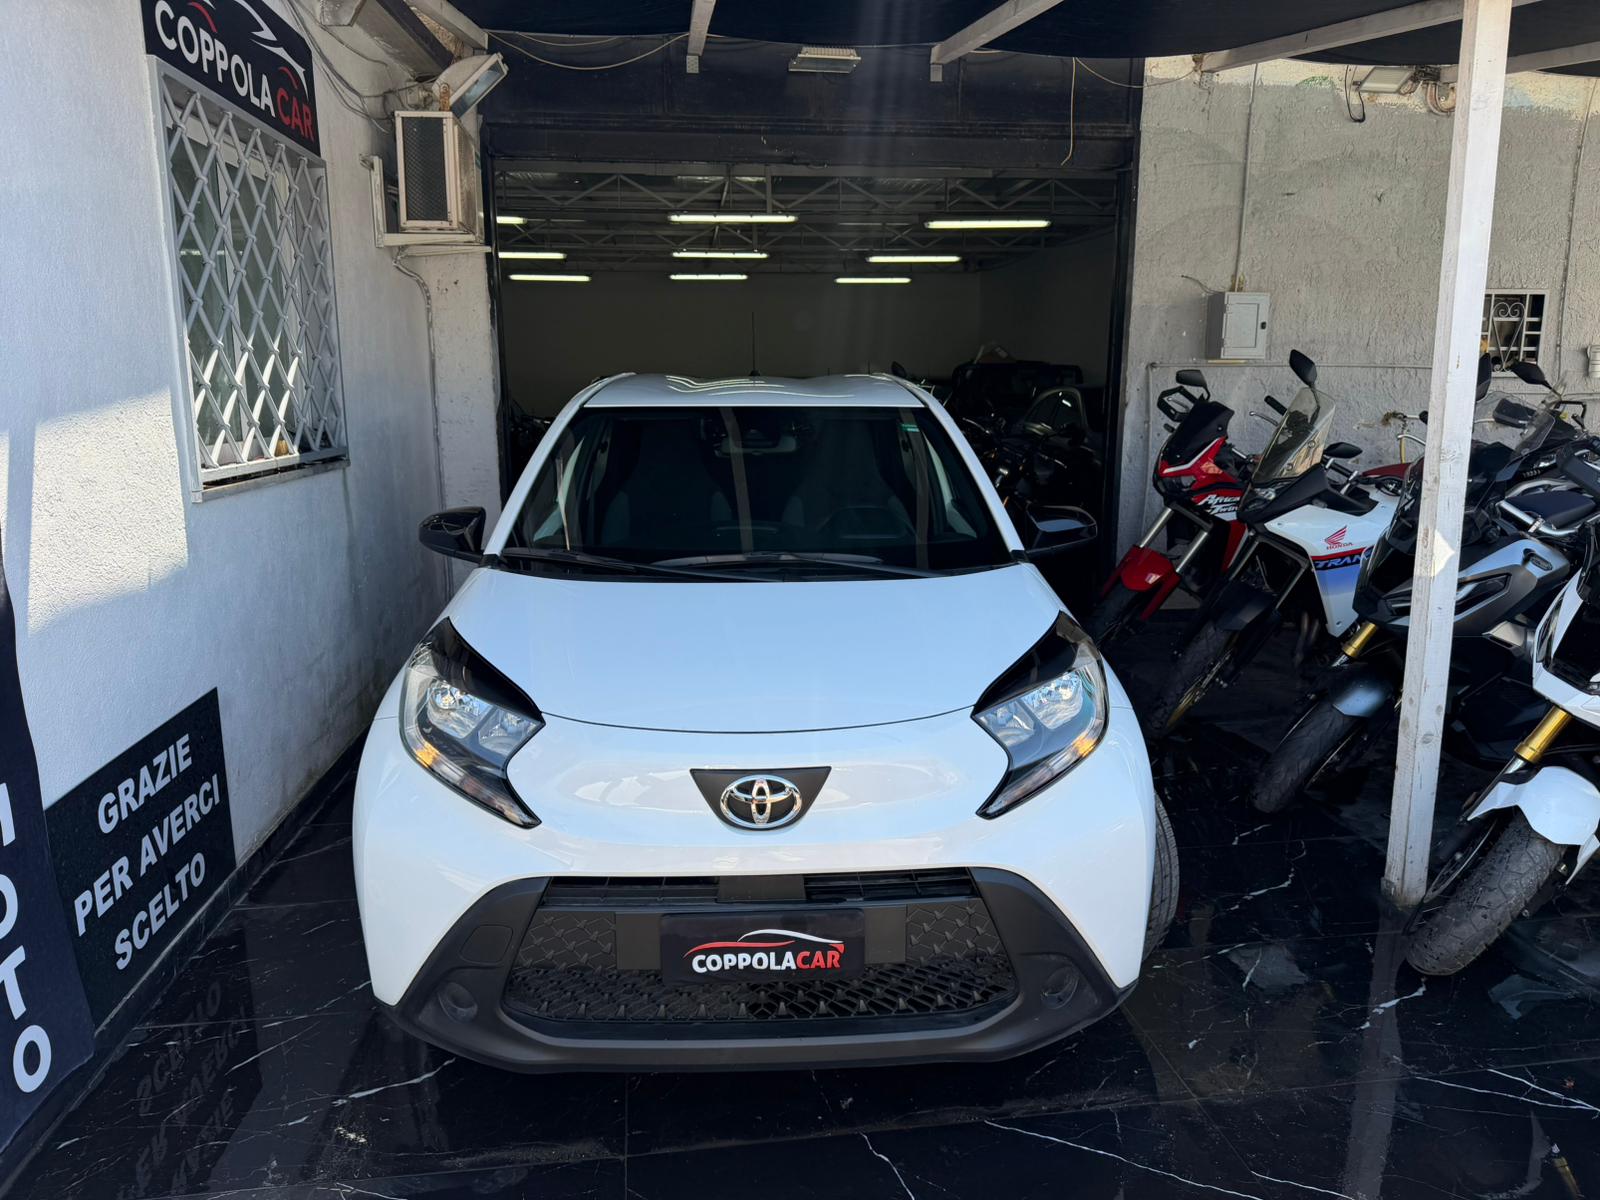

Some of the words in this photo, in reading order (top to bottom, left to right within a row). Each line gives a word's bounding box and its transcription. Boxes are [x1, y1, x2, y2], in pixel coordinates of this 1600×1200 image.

[1327, 541, 1353, 550] HONDA
[98, 733, 192, 834] GRAZIE
[74, 859, 132, 936] PER
[139, 774, 221, 878] AVERCI
[115, 853, 205, 970] SCELTO
